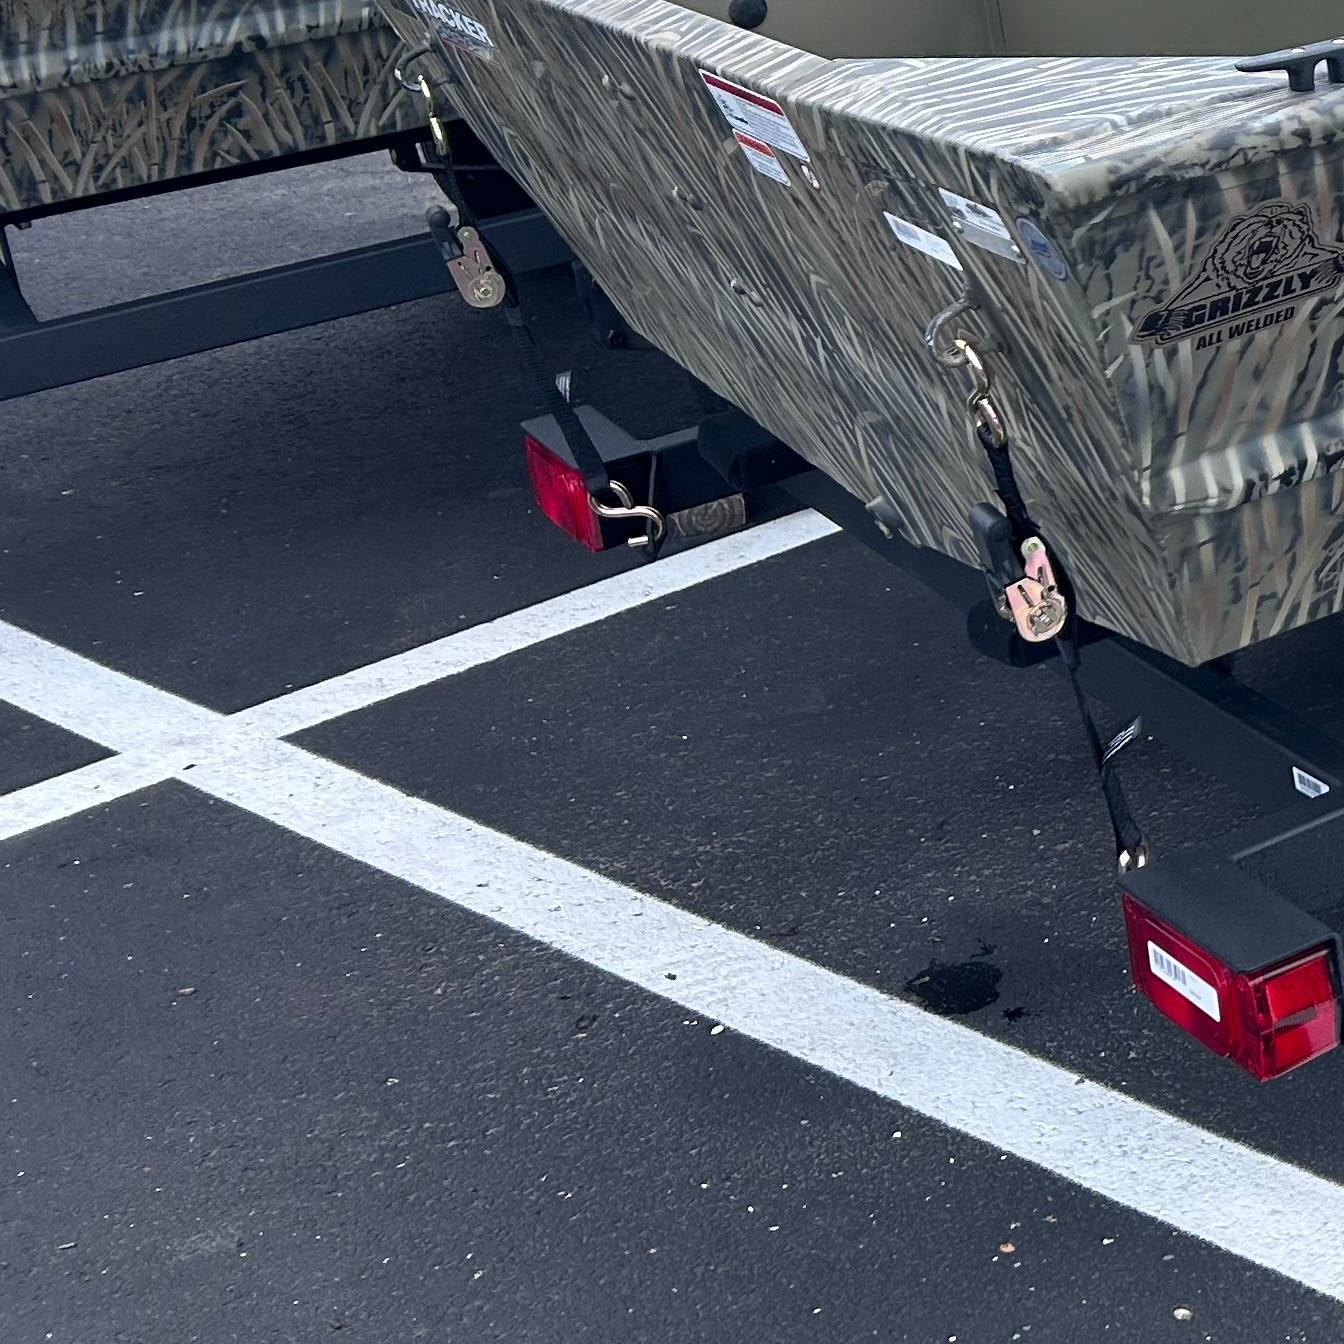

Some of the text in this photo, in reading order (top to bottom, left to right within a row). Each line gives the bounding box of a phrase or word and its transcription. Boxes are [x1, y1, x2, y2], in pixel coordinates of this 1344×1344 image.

[1188, 269, 1317, 329] GRIZZLY
[1195, 306, 1296, 351] ALL WELDED
